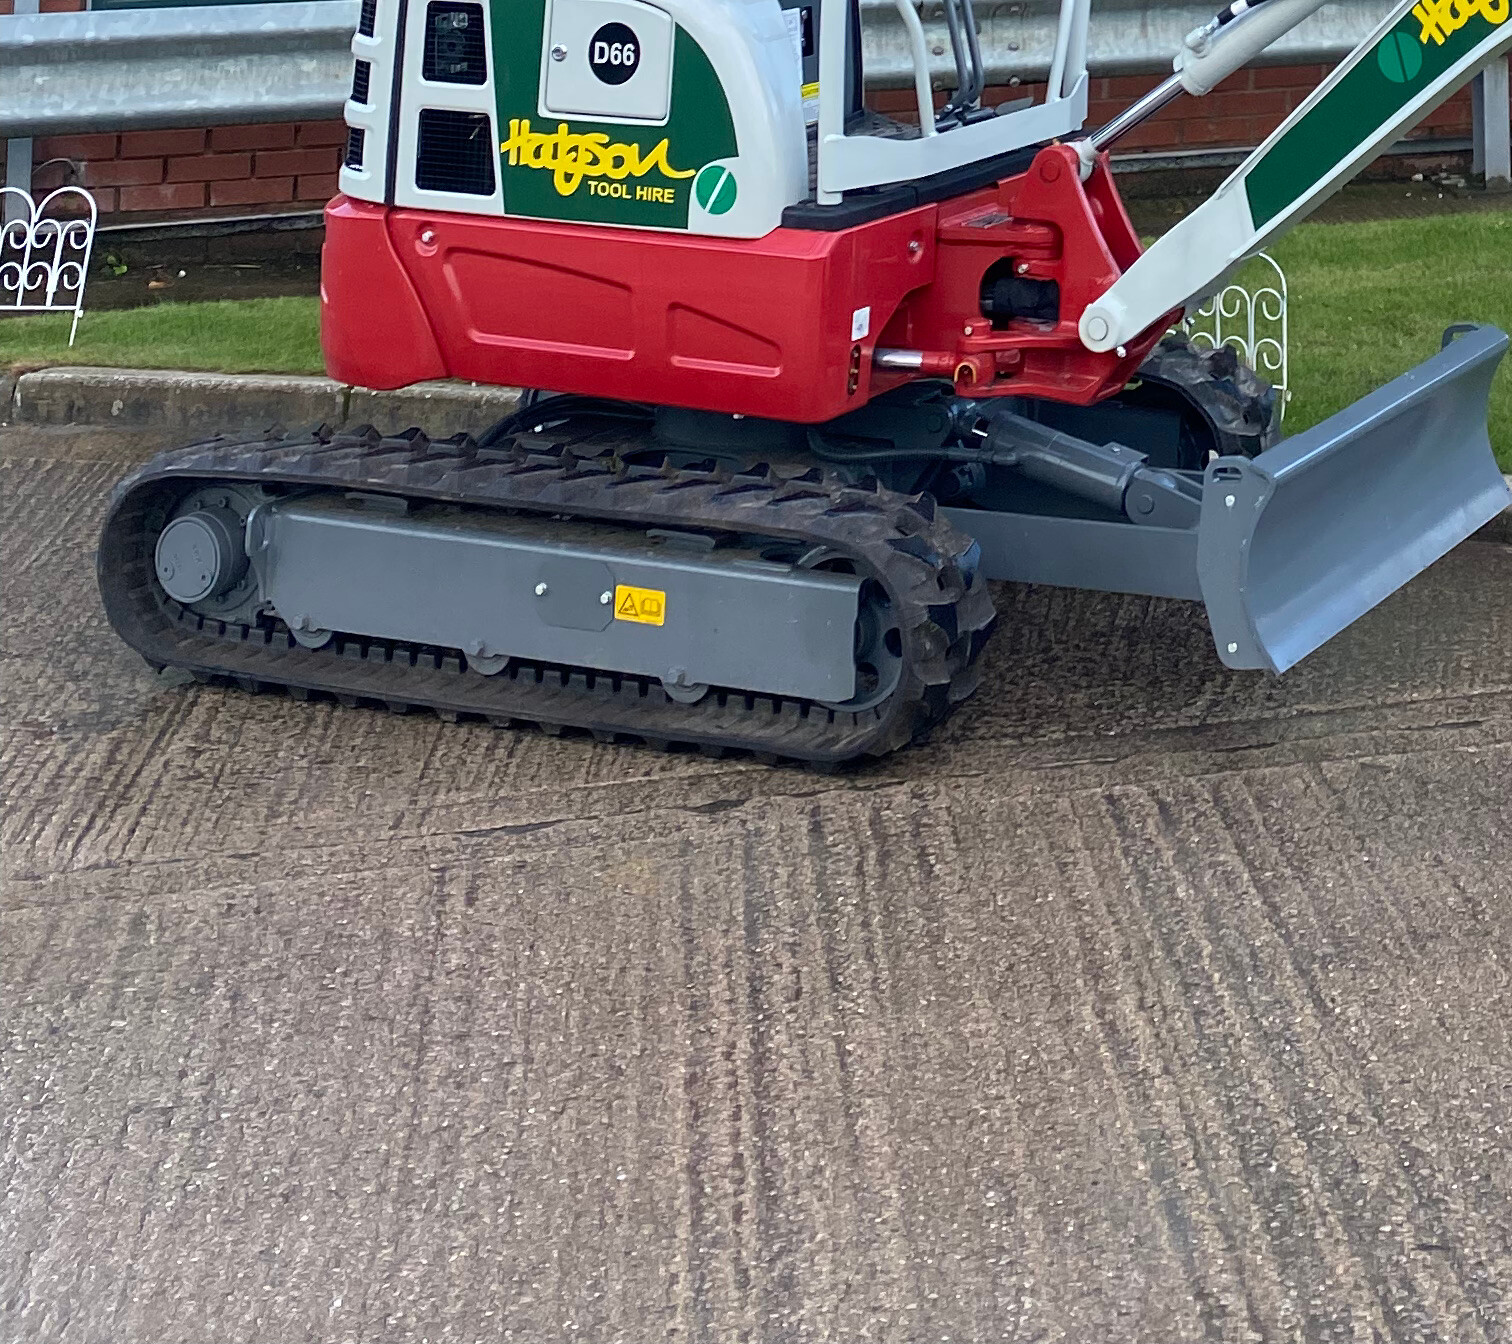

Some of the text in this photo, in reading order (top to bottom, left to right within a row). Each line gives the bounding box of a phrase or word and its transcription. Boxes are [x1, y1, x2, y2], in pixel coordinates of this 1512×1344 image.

[592, 40, 636, 68] D66
[500, 118, 697, 197] Hodgson
[586, 180, 676, 205] TOOL HIRE
